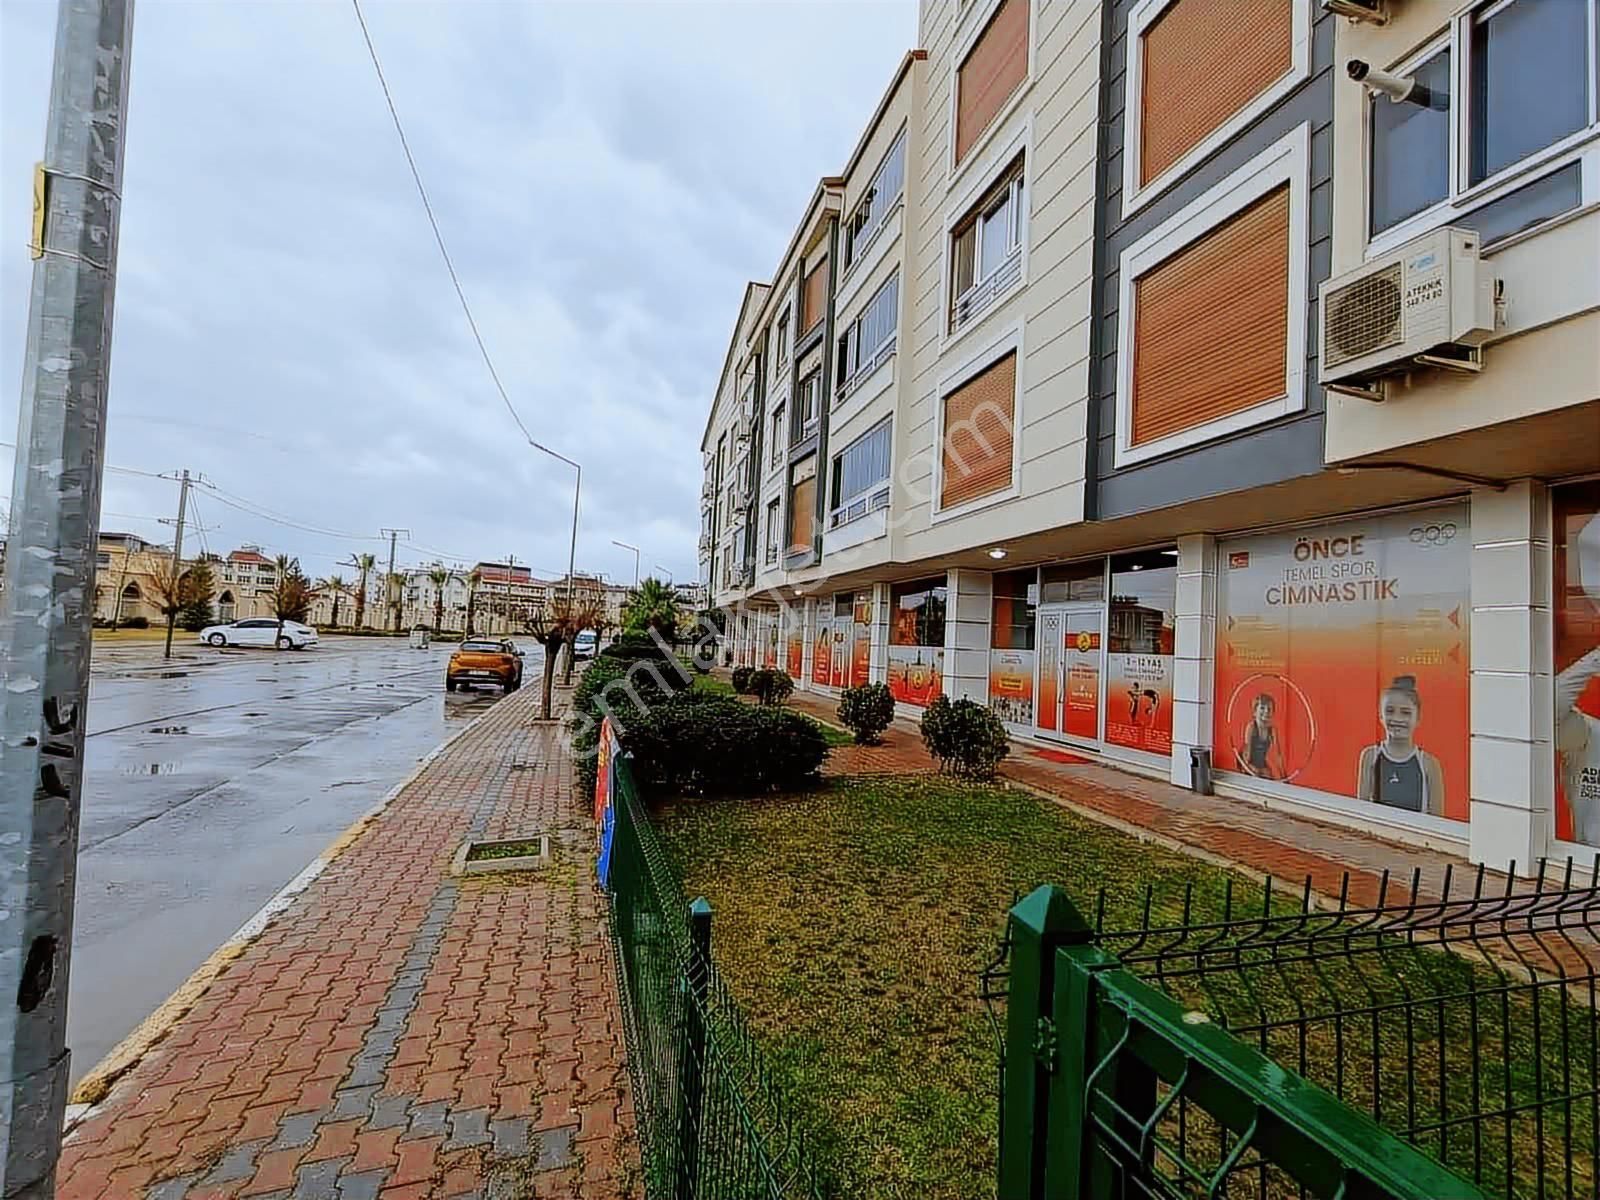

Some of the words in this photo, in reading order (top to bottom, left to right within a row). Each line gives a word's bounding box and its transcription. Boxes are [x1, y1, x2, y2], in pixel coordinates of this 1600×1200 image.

[1294, 535, 1365, 561] ÖNCE
[1285, 566, 1327, 582] TEMEL
[1331, 560, 1376, 578] SPOR
[1266, 575, 1399, 605] CİMNASTİK
